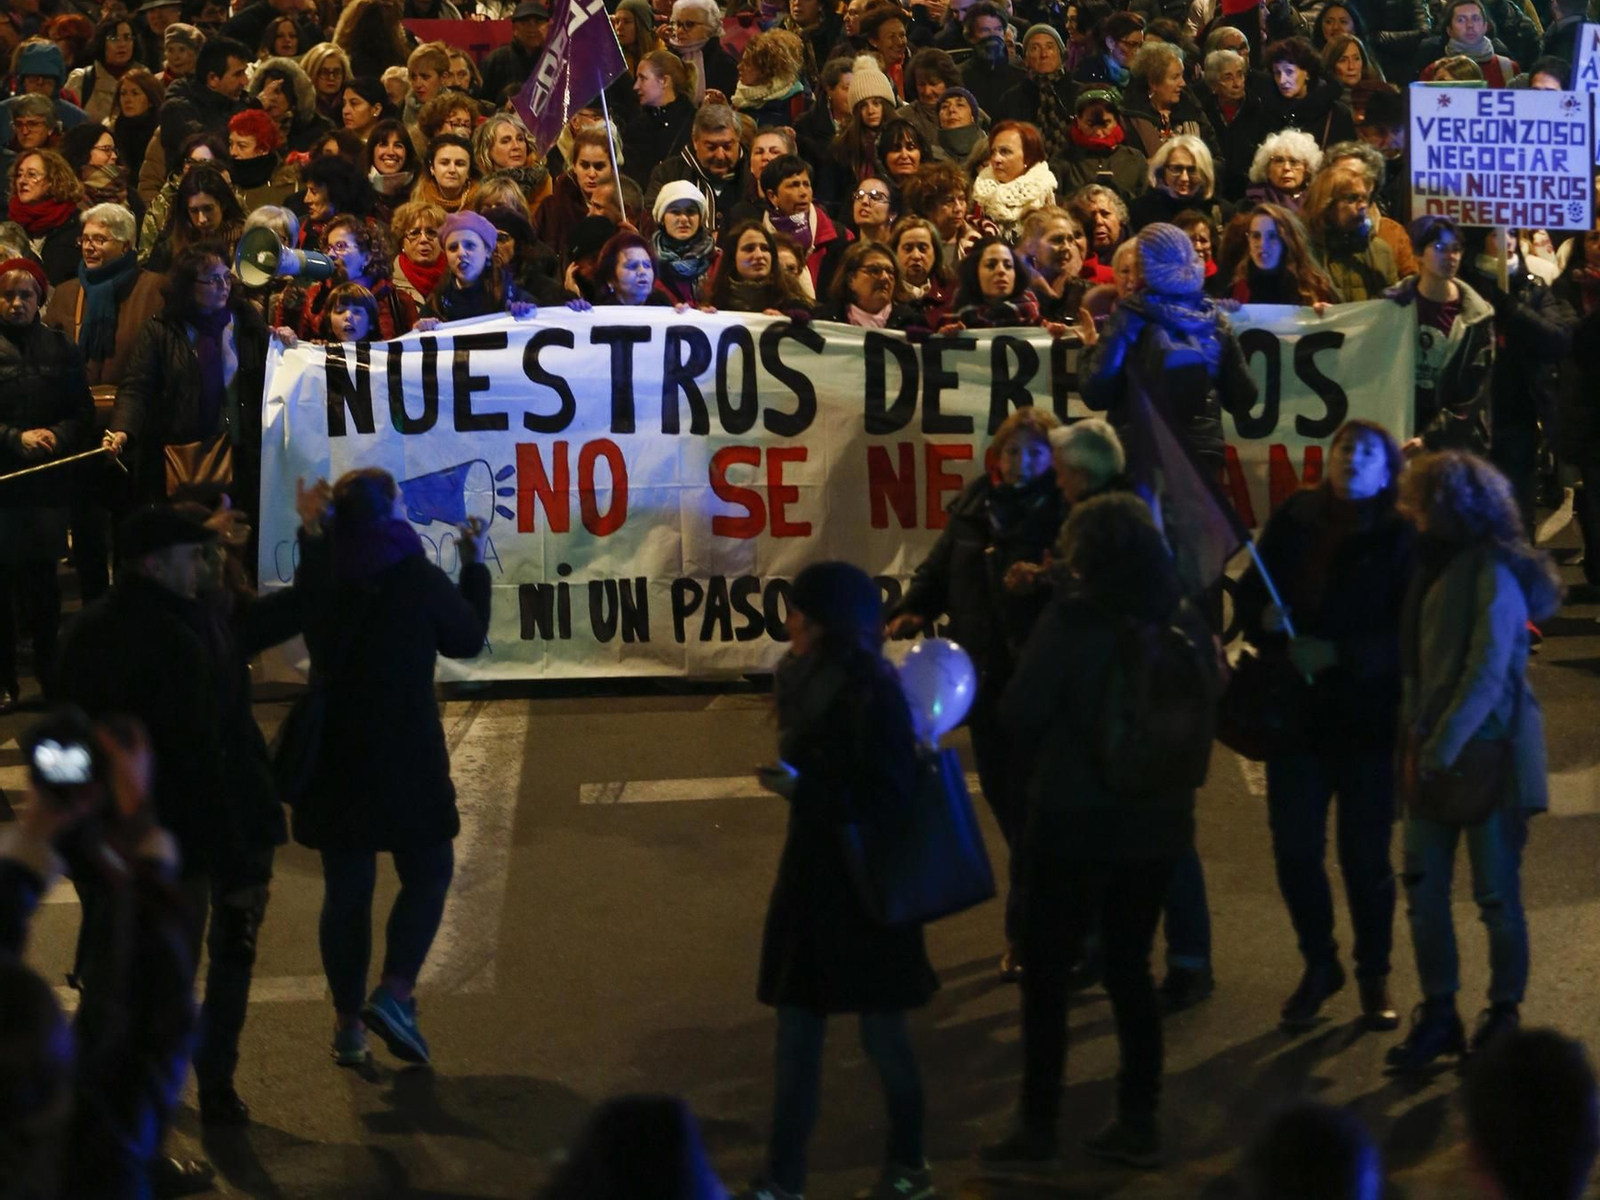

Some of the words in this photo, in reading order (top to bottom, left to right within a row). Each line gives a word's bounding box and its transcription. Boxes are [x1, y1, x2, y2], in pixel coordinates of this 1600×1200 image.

[1477, 91, 1514, 116] ES
[1416, 117, 1585, 146] VERGONZOSO
[1414, 171, 1462, 197] CON
[1466, 173, 1587, 200] NUESTROS
[1426, 199, 1565, 227] DERECHOS
[325, 320, 826, 437] NUESTROS
[864, 328, 1349, 439] DEREOS
[516, 439, 629, 537] NO
[709, 446, 812, 539] SE
[589, 577, 650, 642] UN
[671, 575, 793, 643] PASO
